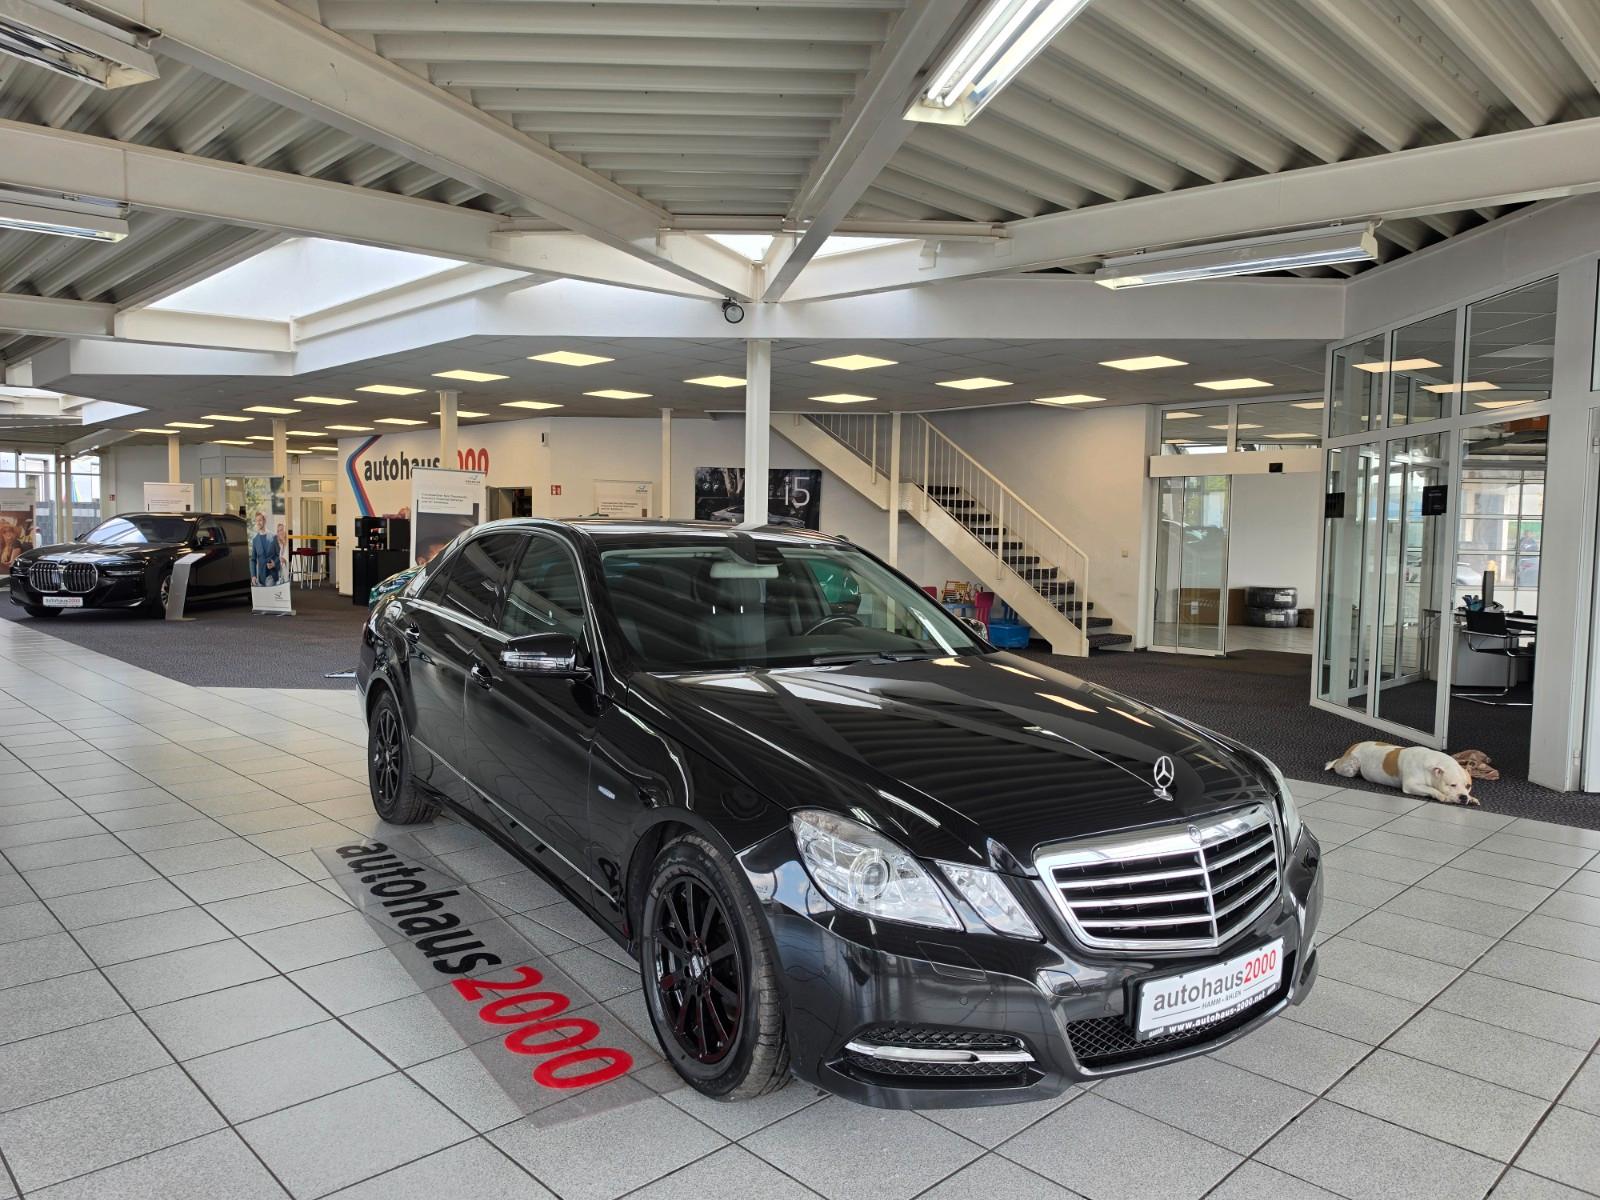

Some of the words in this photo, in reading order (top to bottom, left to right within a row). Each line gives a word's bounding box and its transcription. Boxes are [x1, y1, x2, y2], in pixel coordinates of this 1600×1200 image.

[784, 476, 810, 507] i5
[335, 842, 635, 1089] autohaus2000
[1153, 949, 1277, 1011] autohaus2000
[1169, 990, 1266, 1033] www.autohaus-2000.net
